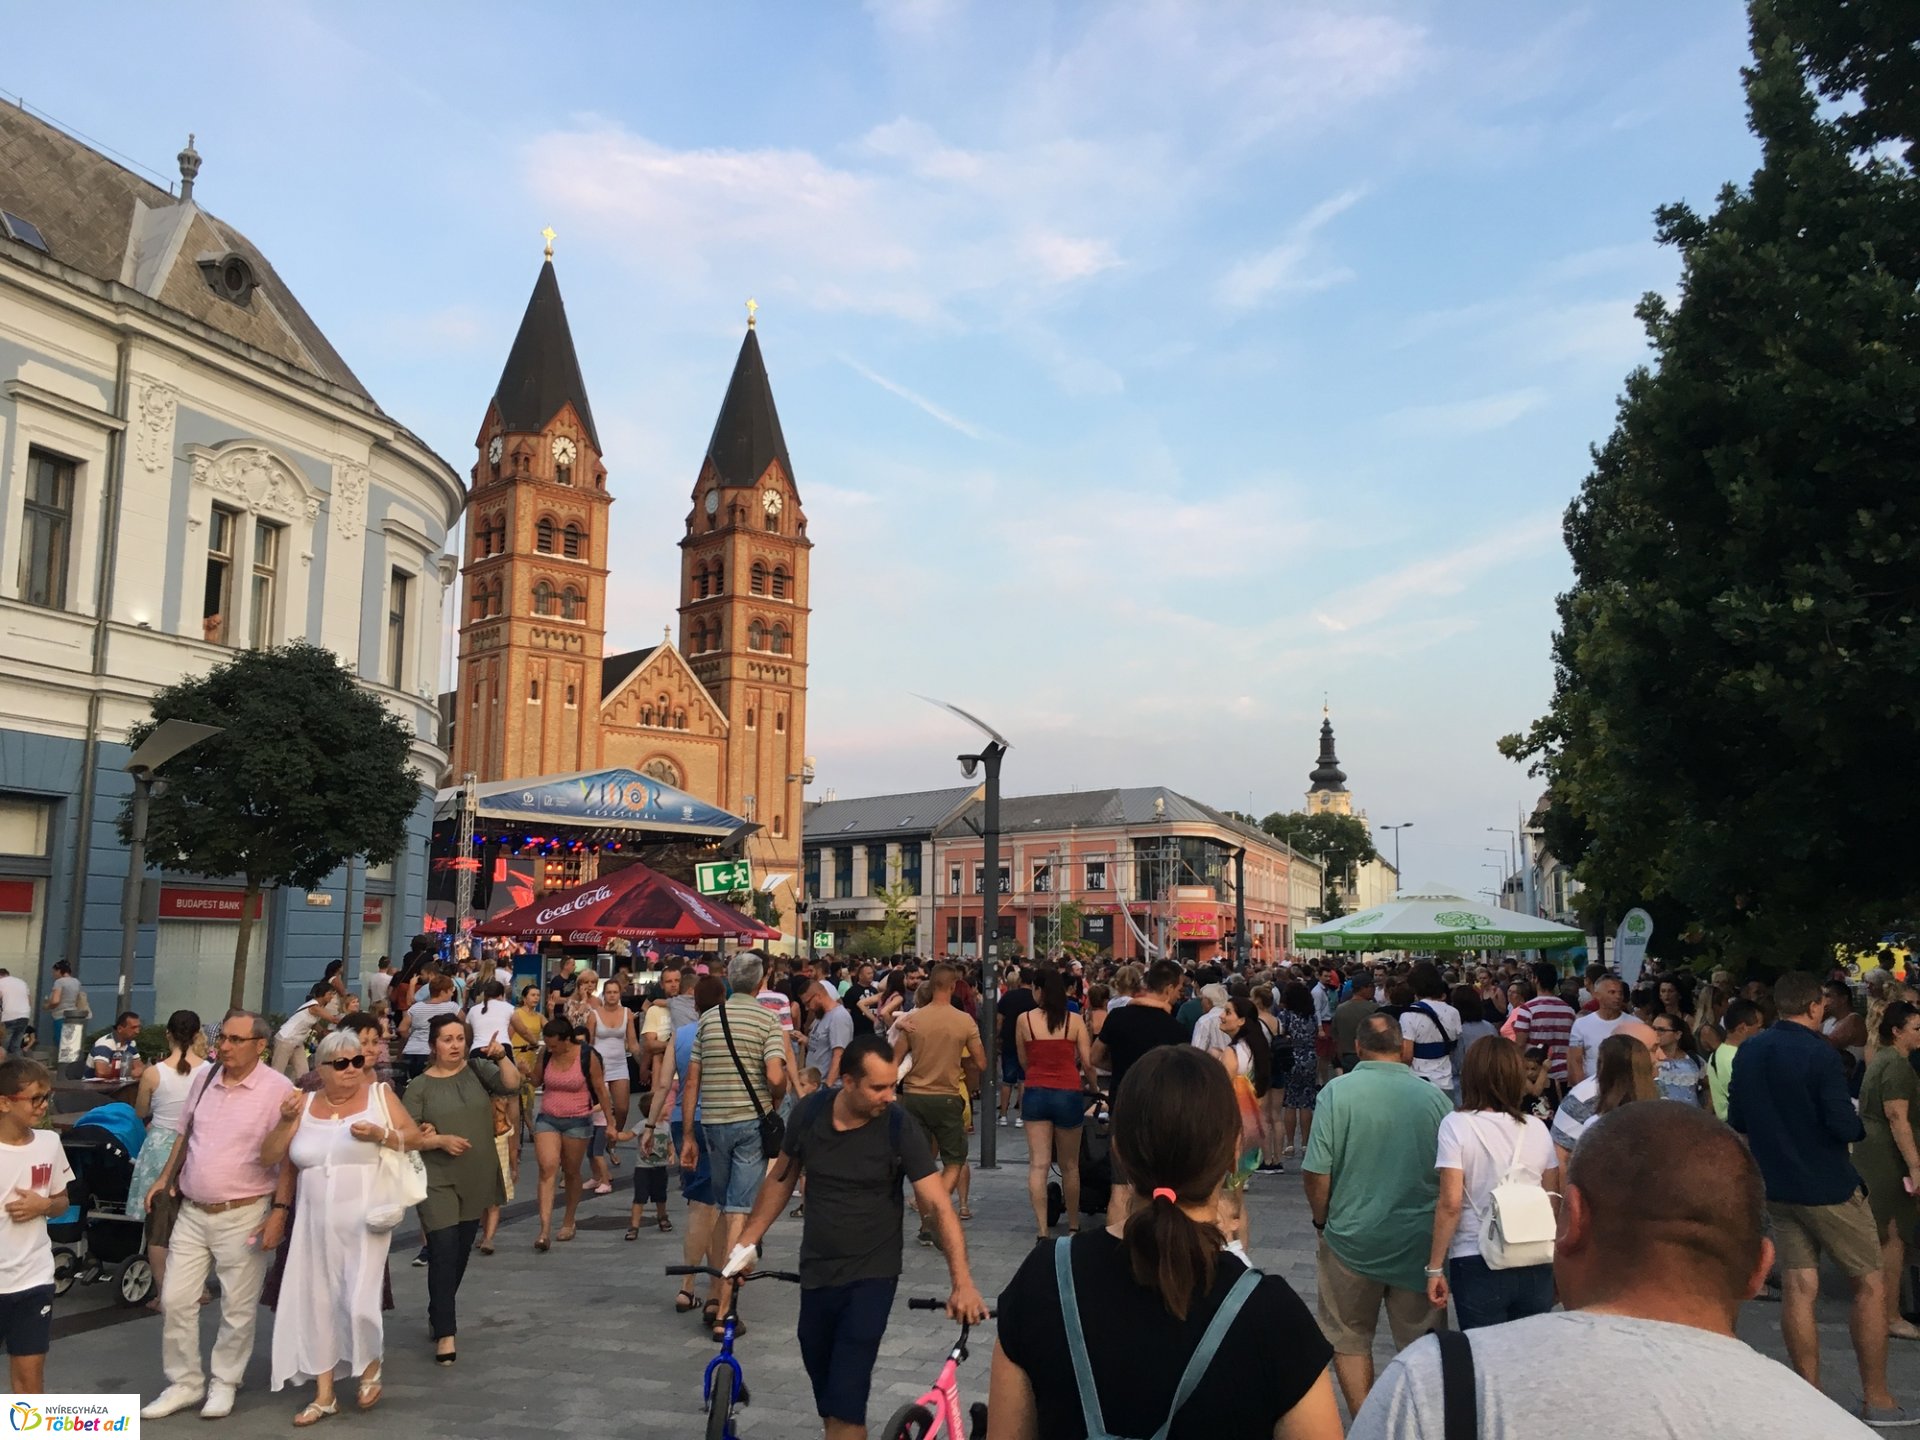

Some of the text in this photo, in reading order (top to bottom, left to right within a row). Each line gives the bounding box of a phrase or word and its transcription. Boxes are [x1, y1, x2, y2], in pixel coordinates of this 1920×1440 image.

[579, 779, 664, 810] VIDOR
[176, 898, 240, 910] BUDAPEST BANK
[536, 884, 612, 925] Coca-Cola
[1454, 934, 1506, 947] SOMERSBY
